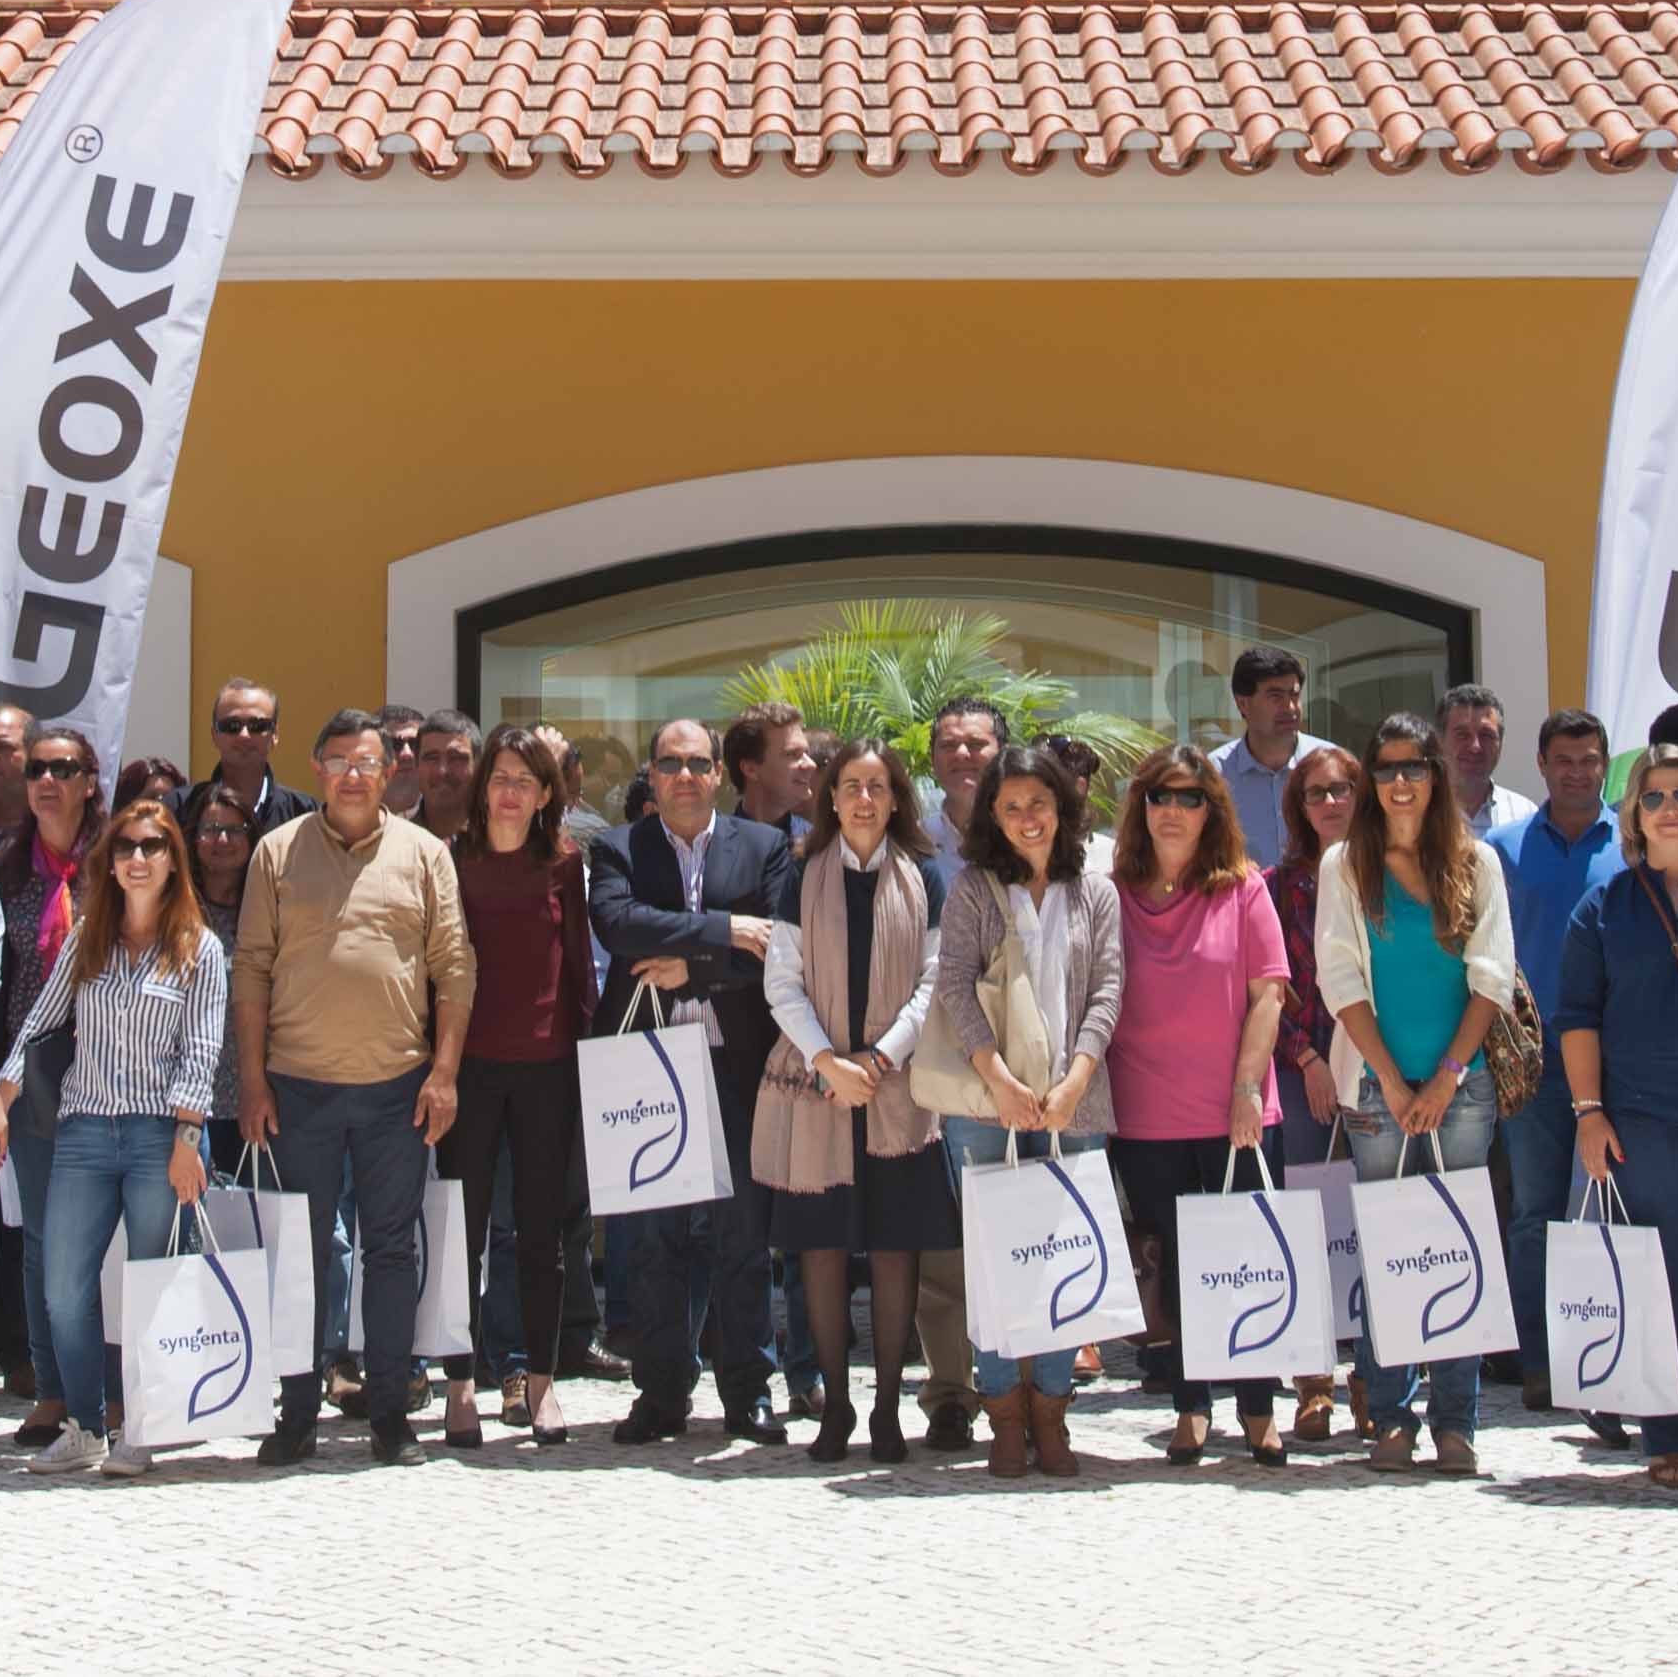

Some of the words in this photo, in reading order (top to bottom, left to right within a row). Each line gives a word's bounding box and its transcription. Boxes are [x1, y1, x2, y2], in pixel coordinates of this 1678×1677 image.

[601, 1098, 677, 1128] syngenta
[1010, 1232, 1093, 1264] syngenta
[1385, 1246, 1469, 1278] syngenta
[1200, 1263, 1285, 1290] syngenta
[1559, 1296, 1617, 1323] syngenta
[158, 1326, 240, 1354] syngenta
